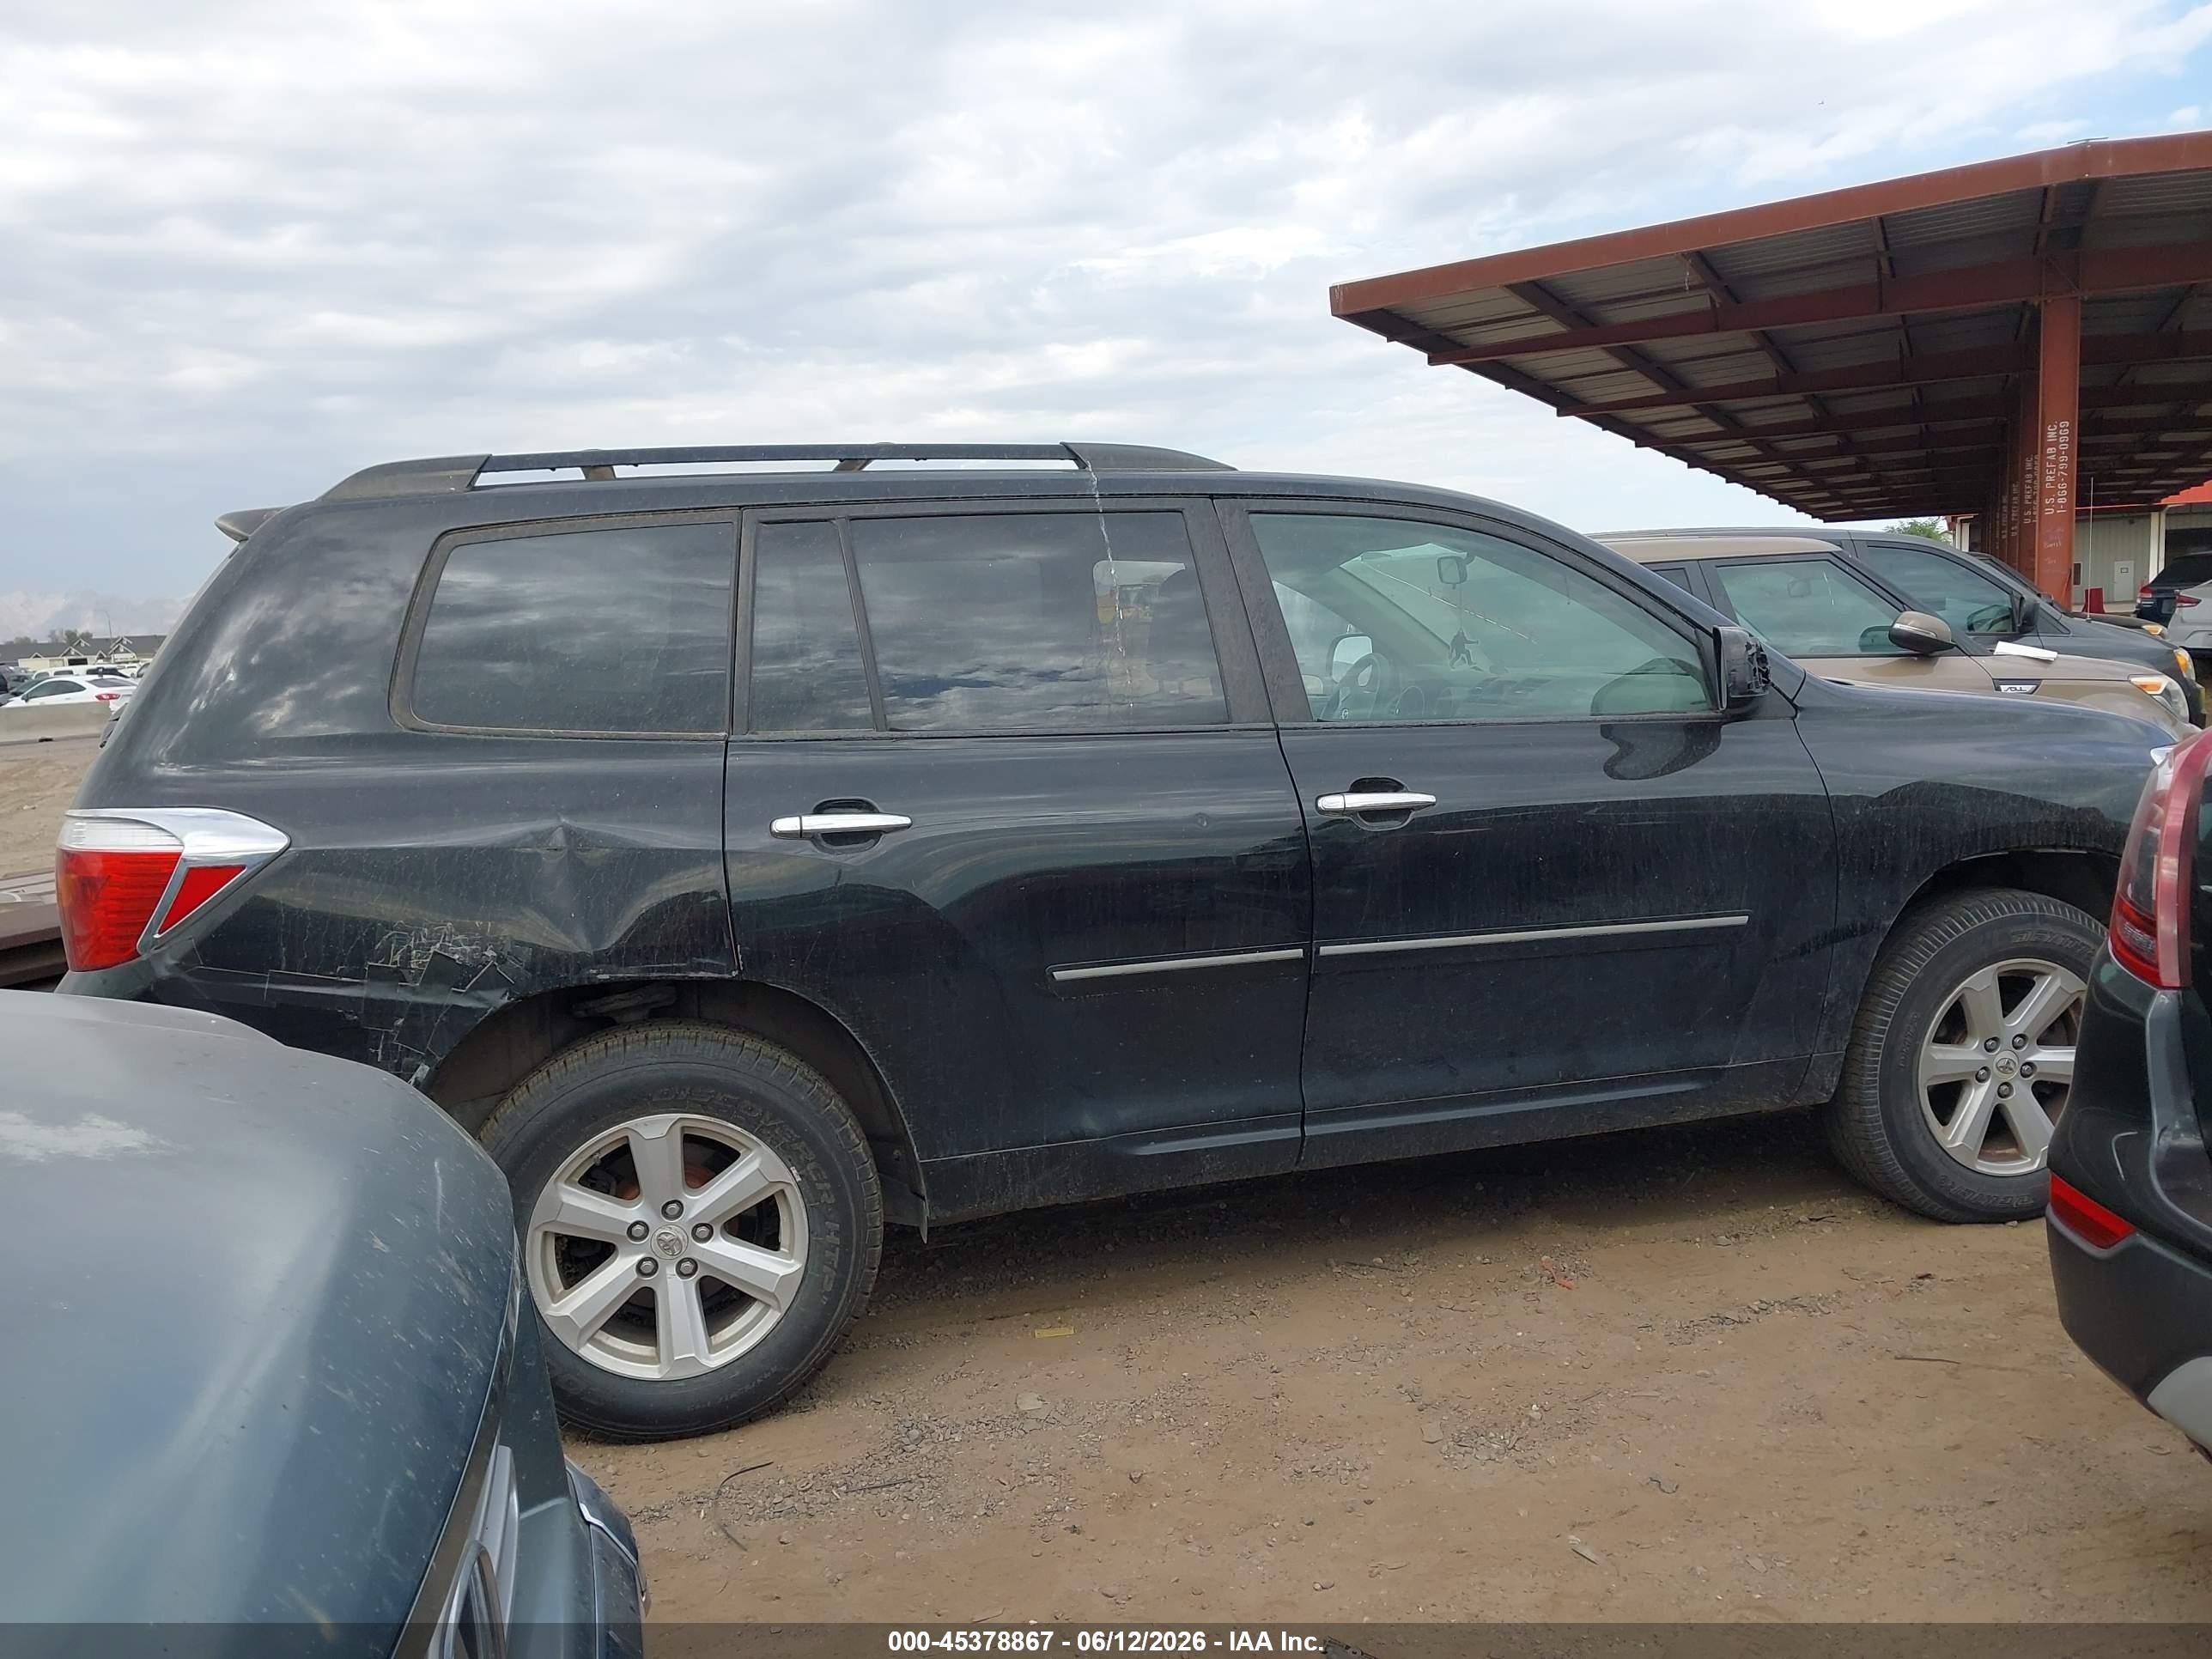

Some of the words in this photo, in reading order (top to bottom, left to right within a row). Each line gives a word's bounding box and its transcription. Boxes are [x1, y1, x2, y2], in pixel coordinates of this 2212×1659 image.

[2046, 421, 2058, 442] INC.
[2045, 447, 2057, 489] PREFAB
[2057, 421, 2069, 514] 1-866-799-0969
[2024, 473, 2033, 505] PREFAB
[2045, 494, 2056, 515] U.S.
